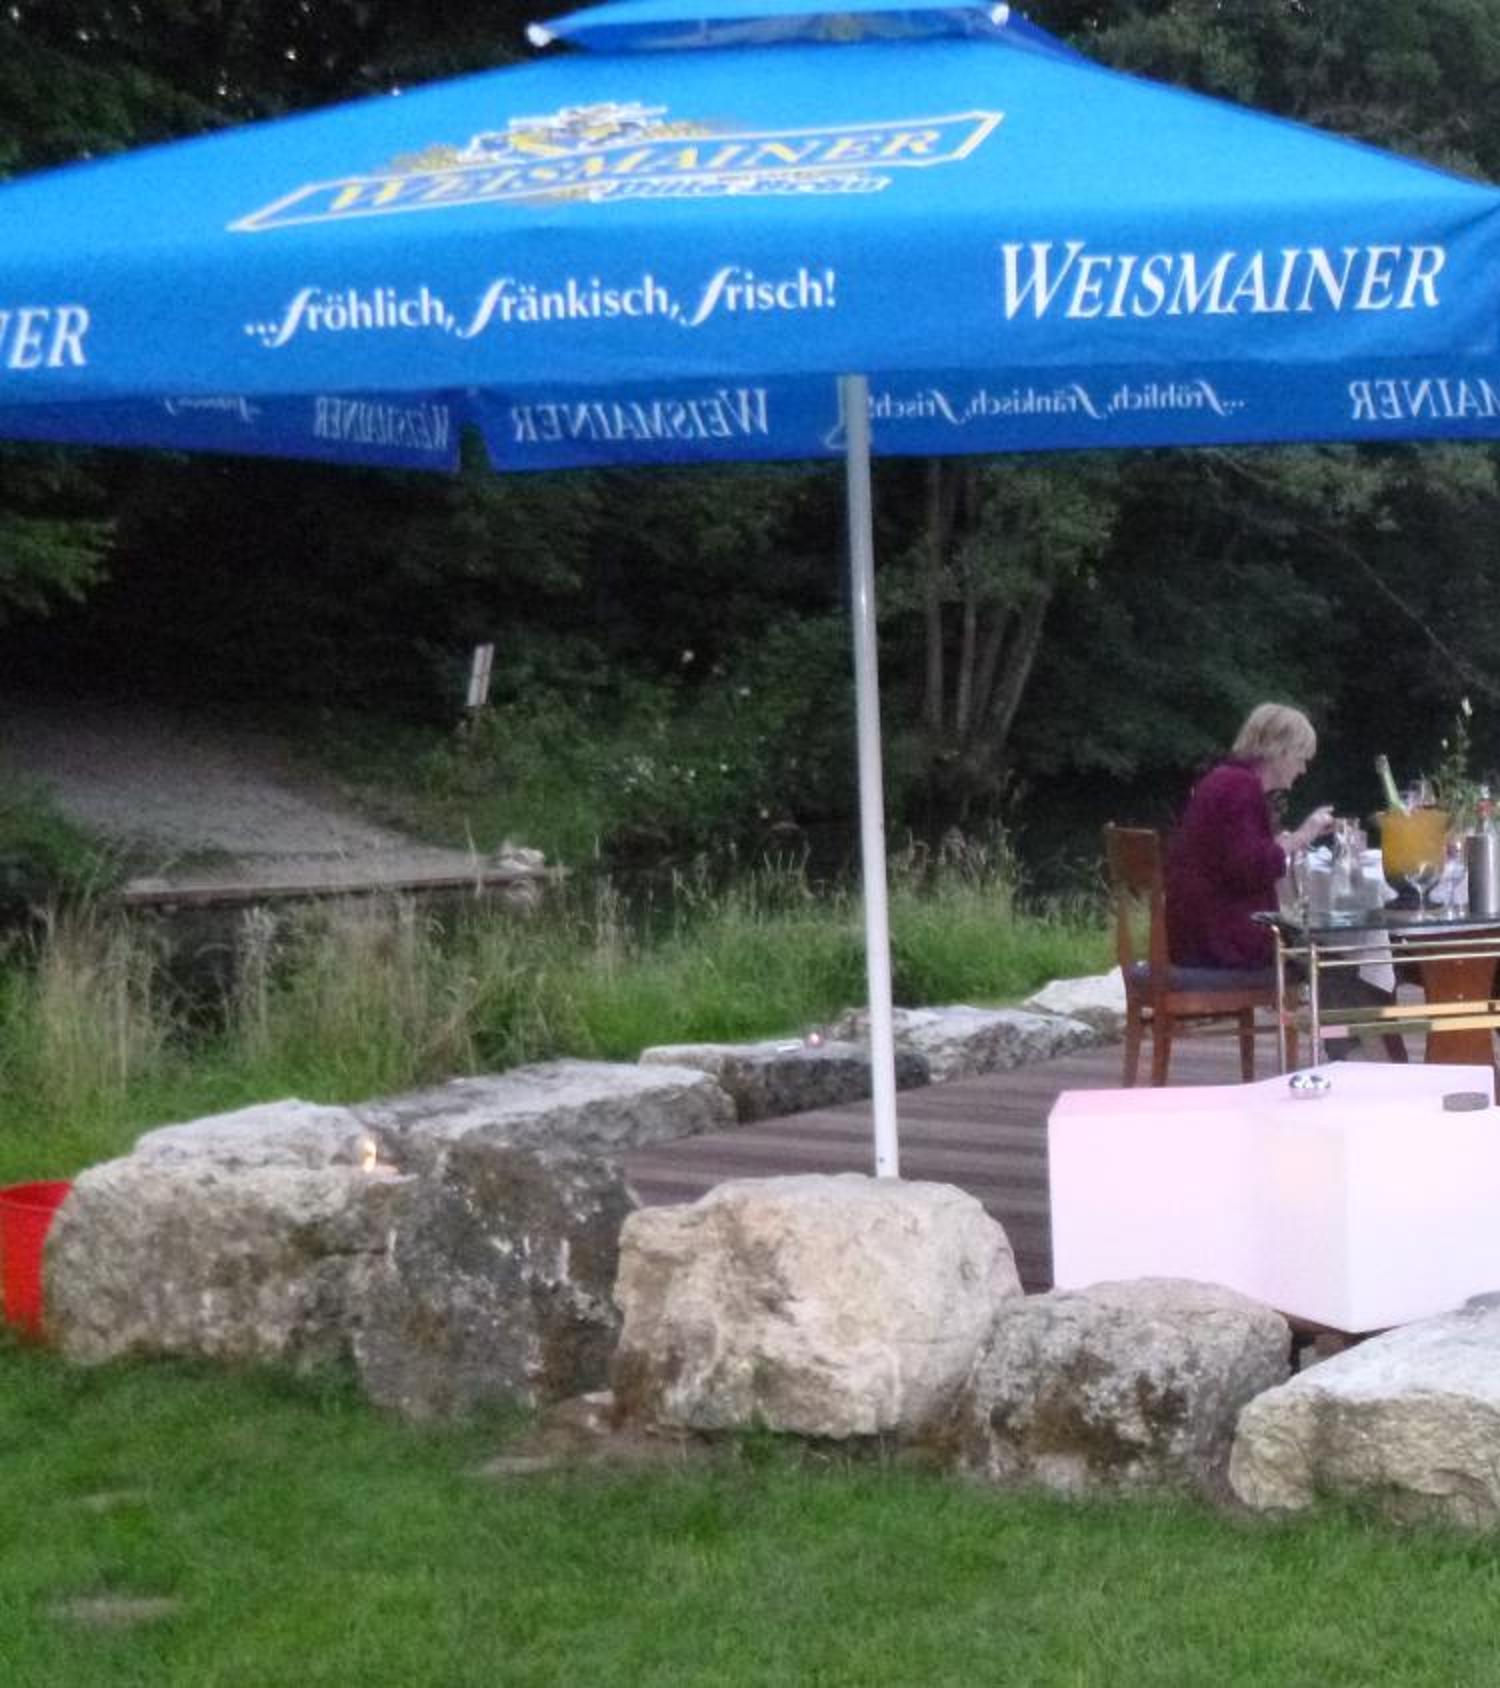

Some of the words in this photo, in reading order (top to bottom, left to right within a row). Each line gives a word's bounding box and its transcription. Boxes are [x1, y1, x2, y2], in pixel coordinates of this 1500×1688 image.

[330, 130, 941, 213] WEISMAINER
[455, 276, 681, 339] fränkisch,
[678, 265, 836, 327] frisch!
[1001, 241, 1446, 321] WEISMAINER
[0, 304, 91, 369] ER
